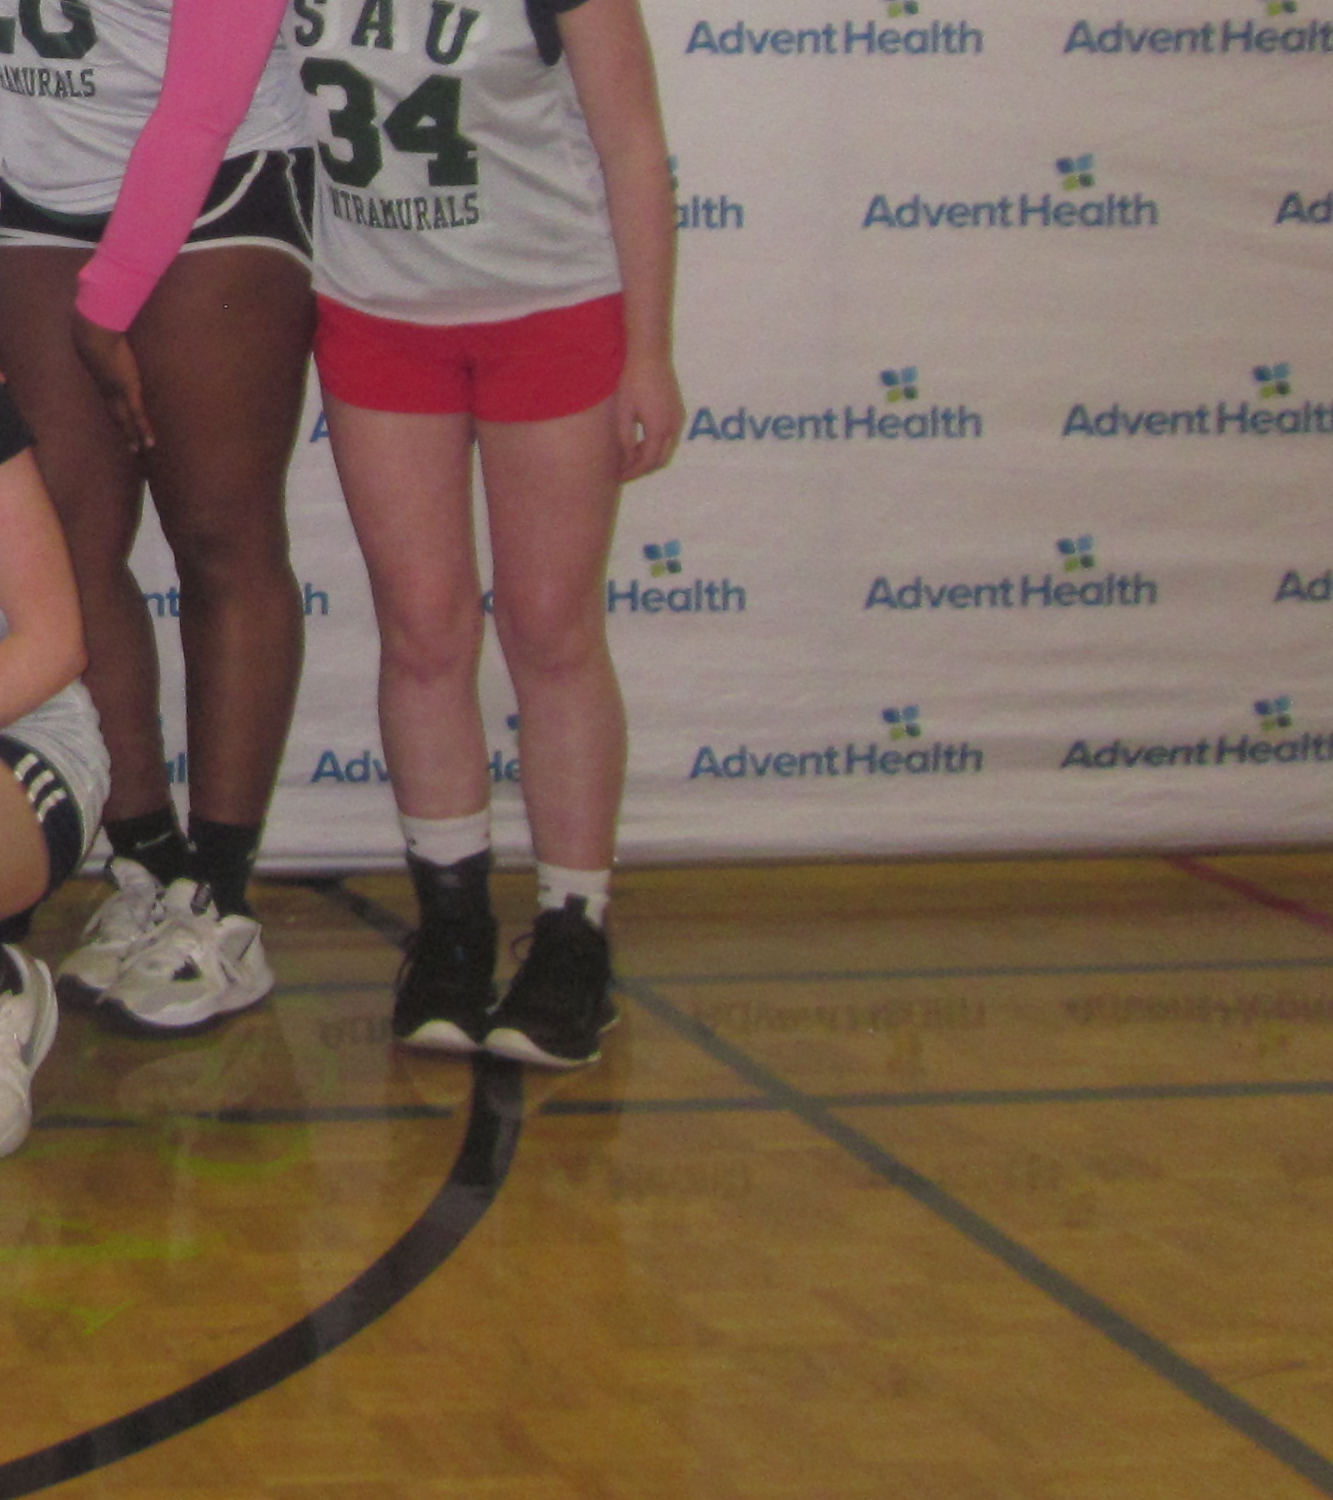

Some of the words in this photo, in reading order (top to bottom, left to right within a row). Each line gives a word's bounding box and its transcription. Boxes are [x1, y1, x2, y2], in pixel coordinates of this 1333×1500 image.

[686, 21, 982, 54] AdventHealth
[300, 57, 480, 188] 34
[863, 194, 1158, 228] AdventHealth
[688, 406, 981, 440] AdventHealth
[866, 574, 1157, 609] AdventHealth
[689, 743, 984, 779] AdventHealth
